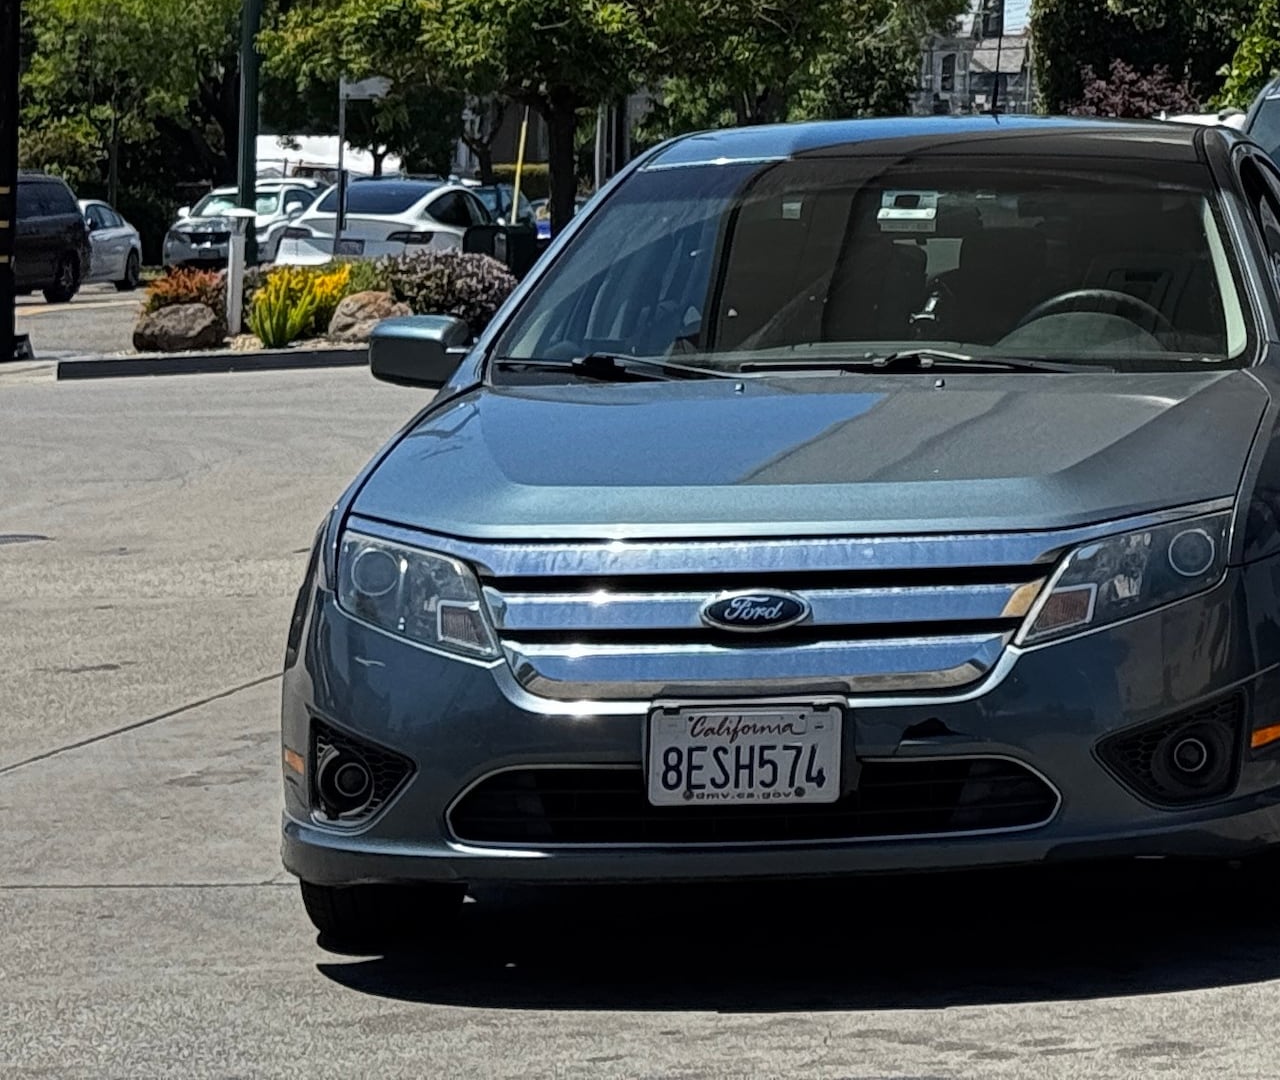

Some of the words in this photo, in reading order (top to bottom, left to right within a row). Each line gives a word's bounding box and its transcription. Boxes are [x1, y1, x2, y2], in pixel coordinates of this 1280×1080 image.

[724, 596, 784, 620] Ford
[690, 716, 806, 743] California
[661, 744, 826, 791] 8ESH574
[696, 791, 792, 801] dmv.ca.gov
